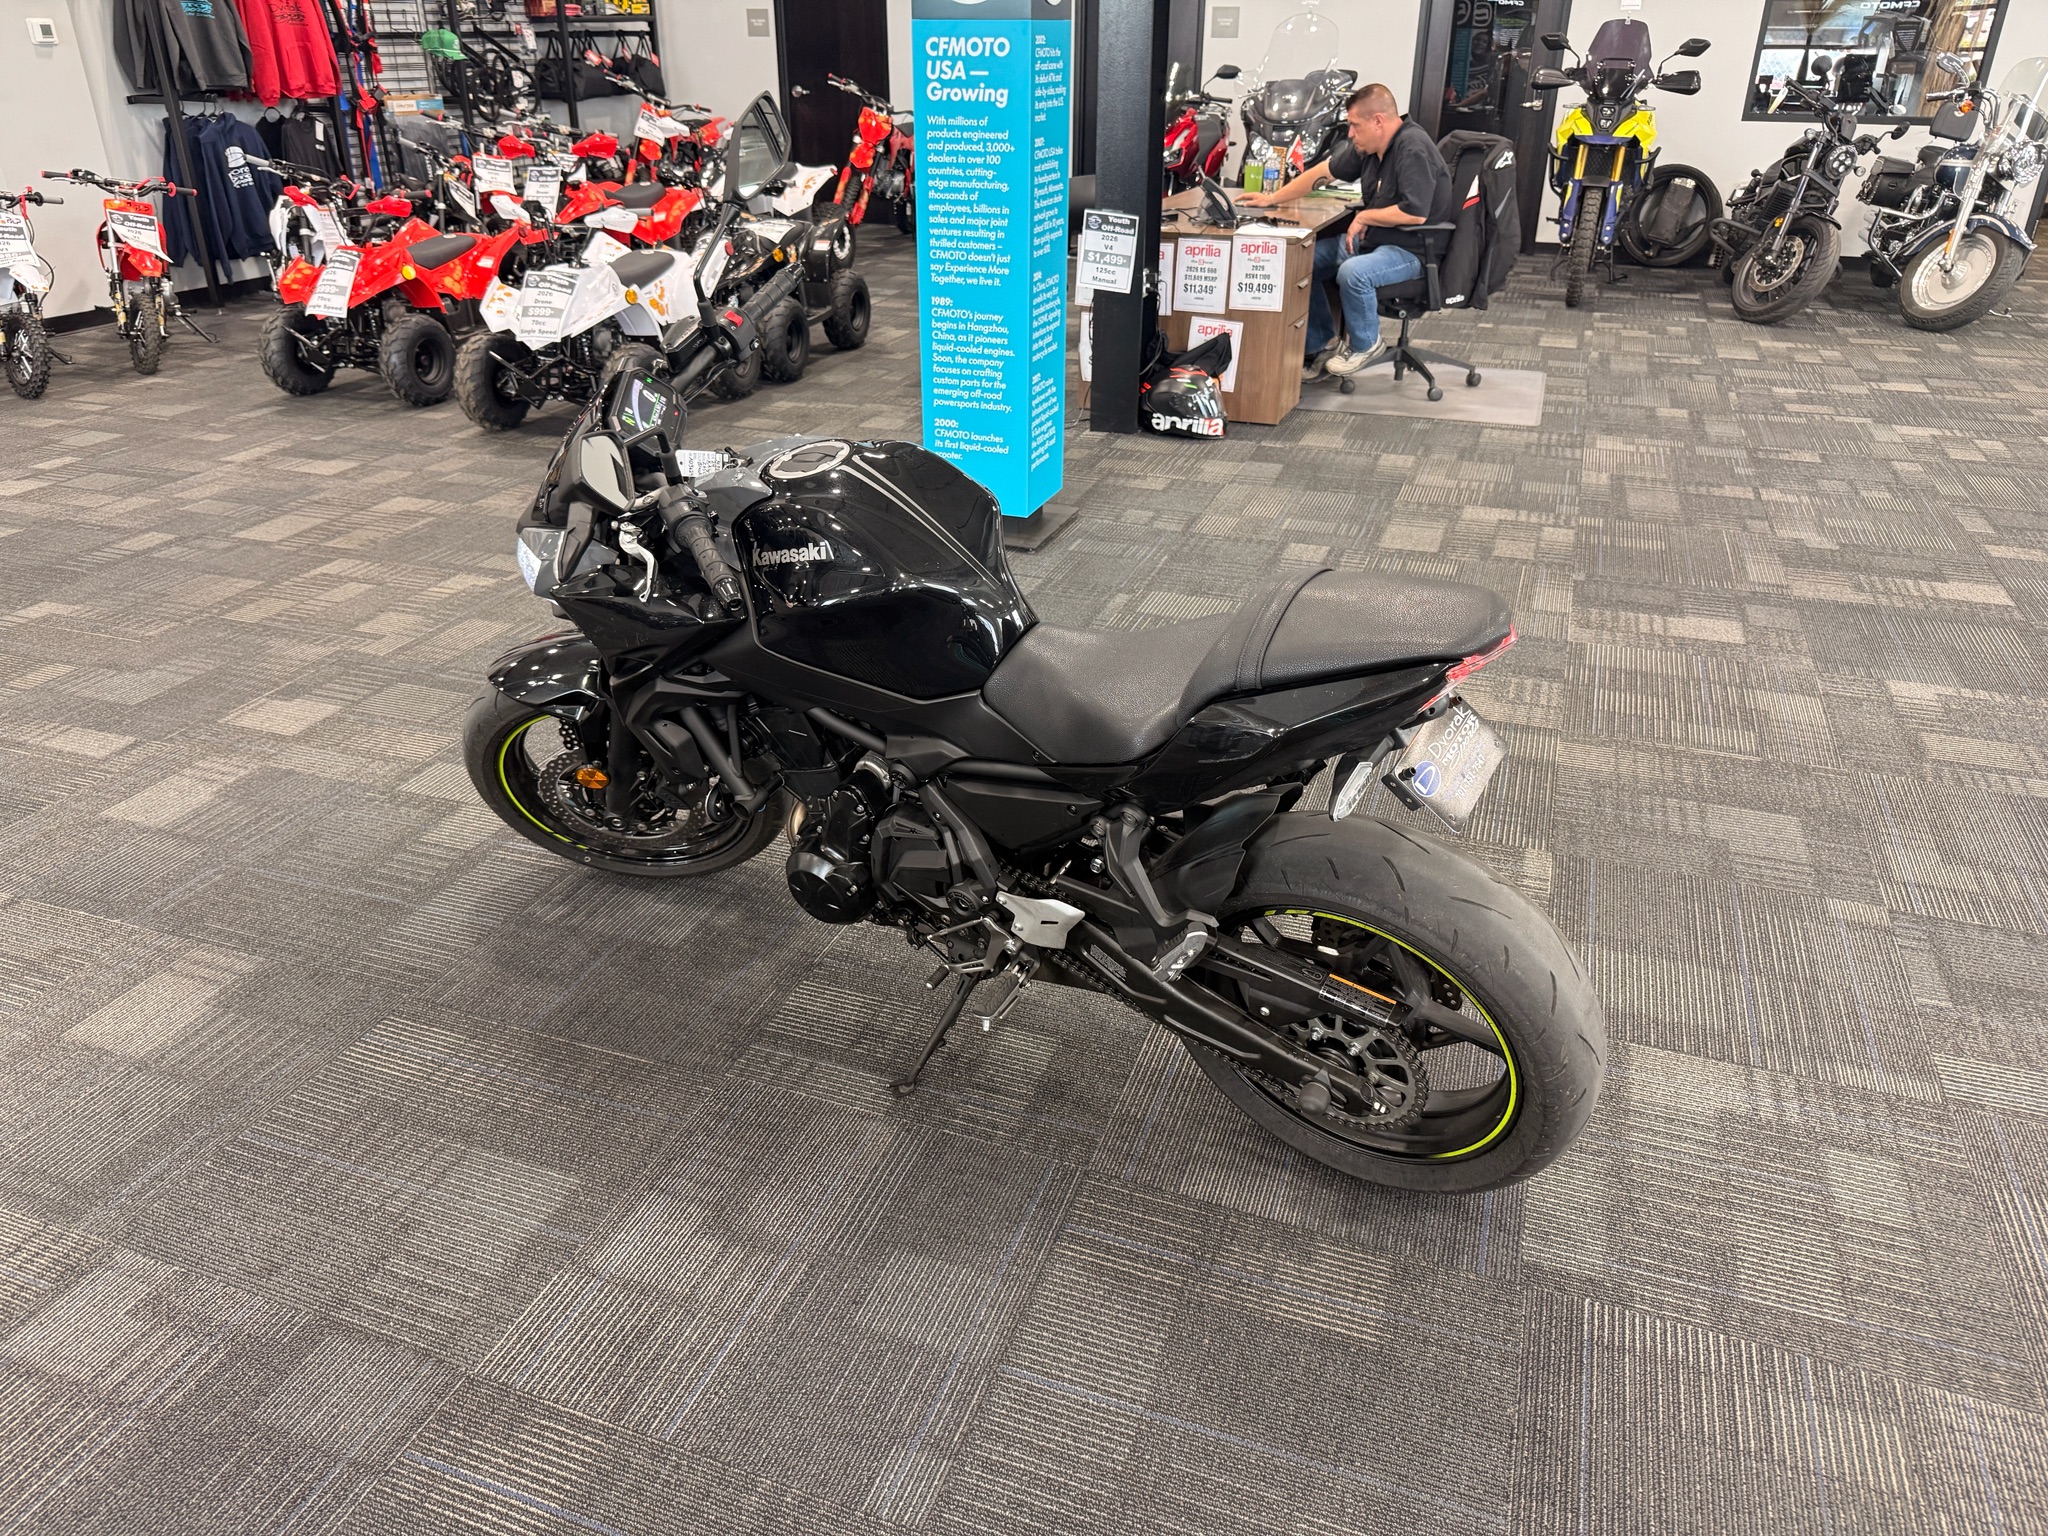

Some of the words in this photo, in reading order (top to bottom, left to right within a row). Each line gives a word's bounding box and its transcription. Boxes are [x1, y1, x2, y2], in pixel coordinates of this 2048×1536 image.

[926, 37, 1010, 57] CFMOTO
[926, 60, 966, 79] USA
[926, 82, 1008, 108] Growing
[926, 116, 946, 124] With
[948, 117, 977, 126] millions
[978, 117, 988, 126] of
[926, 129, 961, 139] products
[962, 130, 1008, 141] engineered
[926, 141, 943, 150] and
[944, 142, 984, 152] produced,
[986, 143, 1014, 152] 3,000+
[928, 153, 956, 163] dealers
[958, 155, 965, 163] in
[986, 155, 1000, 164] 100
[928, 167, 964, 176] countries,
[966, 168, 996, 179] cutting-
[928, 179, 948, 189] edge
[950, 180, 1009, 193] manufacturing,
[928, 190, 968, 200] thousands
[970, 192, 978, 200] of
[928, 203, 972, 214] employees,
[972, 204, 1000, 214] billions
[1002, 206, 1009, 214] in
[928, 214, 948, 223] sales
[950, 216, 965, 224] and
[966, 218, 989, 227] major
[990, 218, 1008, 228] joint
[1108, 216, 1130, 224] Youth
[930, 228, 961, 236] ventures
[962, 229, 996, 240] resulting
[1101, 225, 1134, 234] Off-Road
[930, 238, 956, 248] thrilled
[958, 241, 995, 250] customers
[1241, 241, 1277, 255] aprilia
[930, 250, 967, 260] CFMOTO
[996, 255, 1010, 264] just
[1185, 244, 1221, 258] aprilia
[930, 264, 944, 272] say
[944, 262, 987, 273] Experience
[988, 266, 1009, 274] More
[546, 275, 569, 285] Youth
[930, 272, 965, 285] Together,
[978, 276, 992, 285] live
[1092, 276, 1116, 284] Manual
[538, 283, 572, 293] Off-Road
[932, 297, 953, 306] 1989:
[974, 312, 1003, 323] journey
[932, 320, 957, 331] begins
[966, 322, 1008, 334] Hangzhou,
[932, 331, 956, 341] China,
[974, 335, 1007, 344] pioneers
[932, 341, 982, 354] liquid-cooled
[984, 348, 1014, 357] engines.
[932, 353, 953, 363] Soon,
[954, 355, 967, 363] the
[968, 359, 1004, 369] company
[932, 364, 960, 374] focuses
[972, 368, 1002, 380] crafting
[982, 379, 993, 387] for
[994, 381, 1006, 389] the
[934, 388, 969, 398] emerging
[970, 389, 1002, 400] off-road
[934, 398, 979, 408] powersports
[980, 402, 1011, 413] industry.
[934, 418, 958, 428] 2000:
[934, 429, 970, 439] CFMOTO
[970, 432, 1003, 442] launches
[944, 440, 958, 448] first
[960, 441, 1008, 455] liquid-cooled
[753, 542, 827, 567] Kawasaki
[1428, 706, 1472, 759] Dvorak
[1442, 715, 1477, 766] MOTOR
